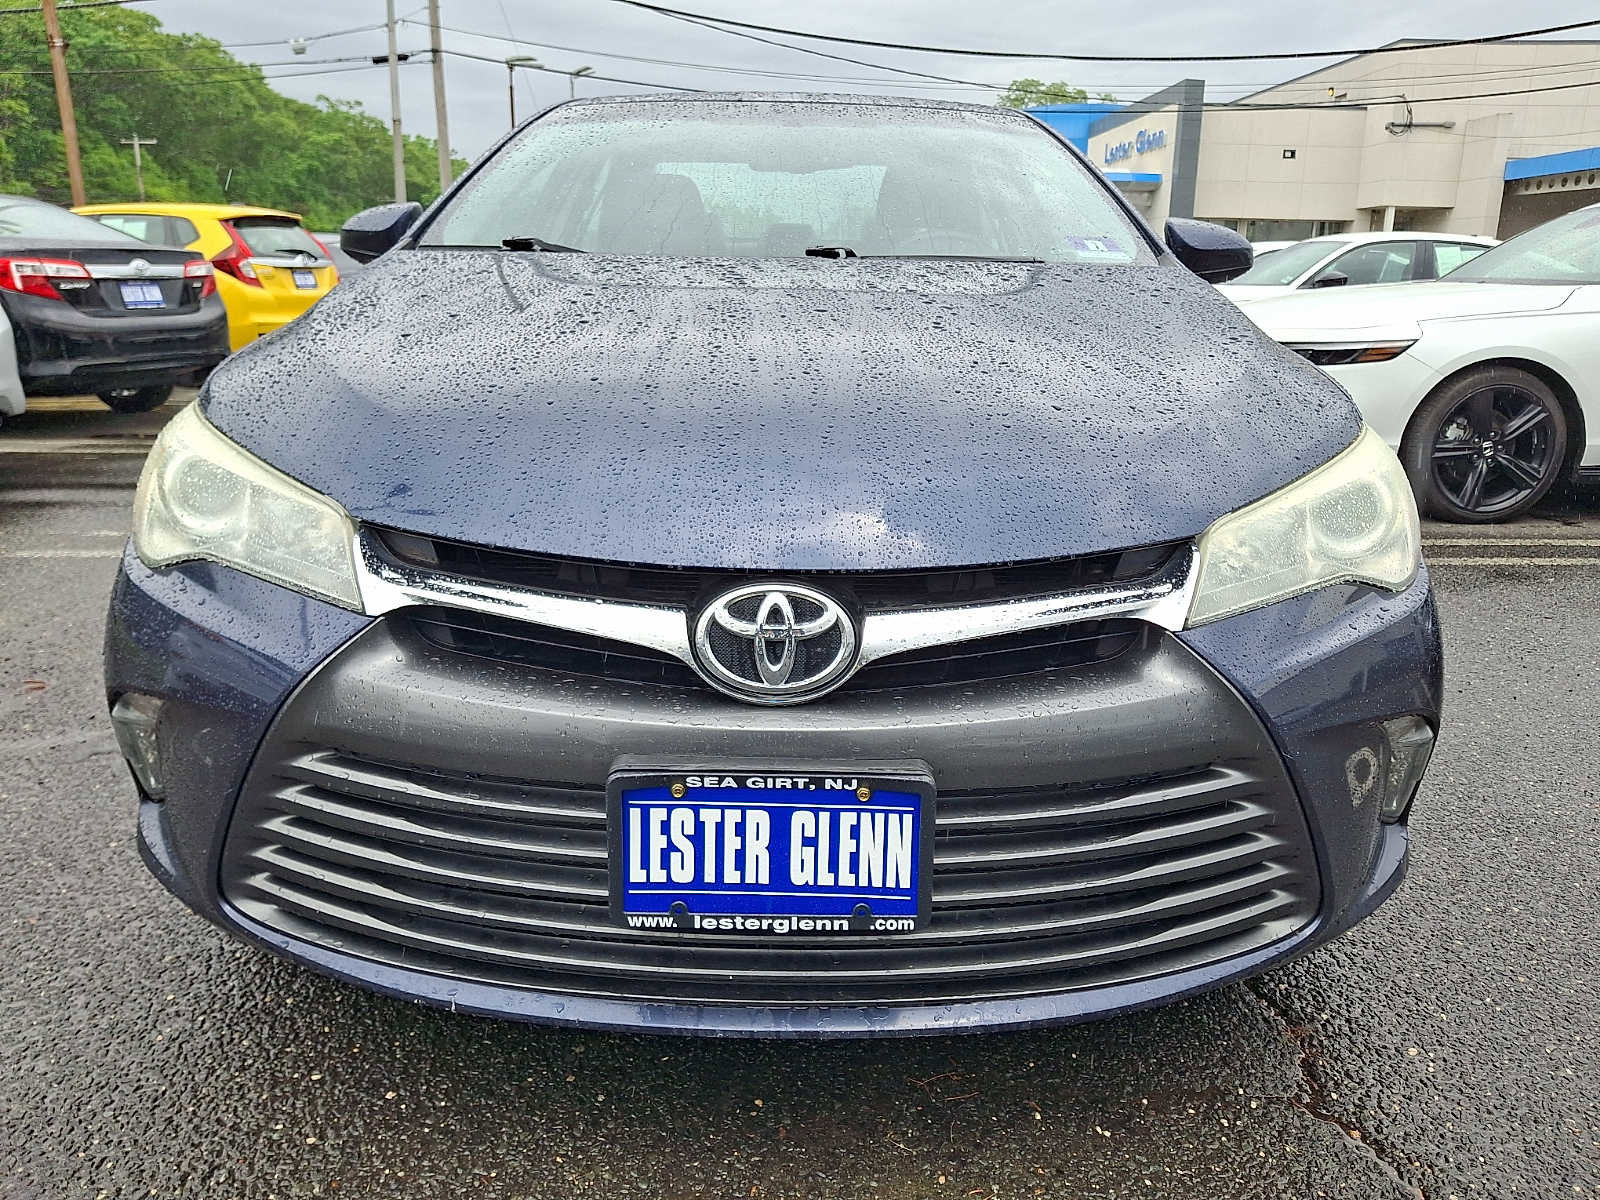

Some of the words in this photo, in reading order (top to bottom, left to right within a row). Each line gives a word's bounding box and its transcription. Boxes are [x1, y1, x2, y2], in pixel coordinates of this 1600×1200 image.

[1104, 141, 1133, 164] Lester
[685, 776, 738, 789] SEA
[746, 777, 816, 791] GIRT,
[824, 778, 857, 791] NJ
[628, 807, 770, 885] LESTER
[790, 810, 913, 889] GLENN
[627, 916, 678, 928] www.
[694, 915, 849, 933] lesterglenn
[870, 918, 915, 931] .com
